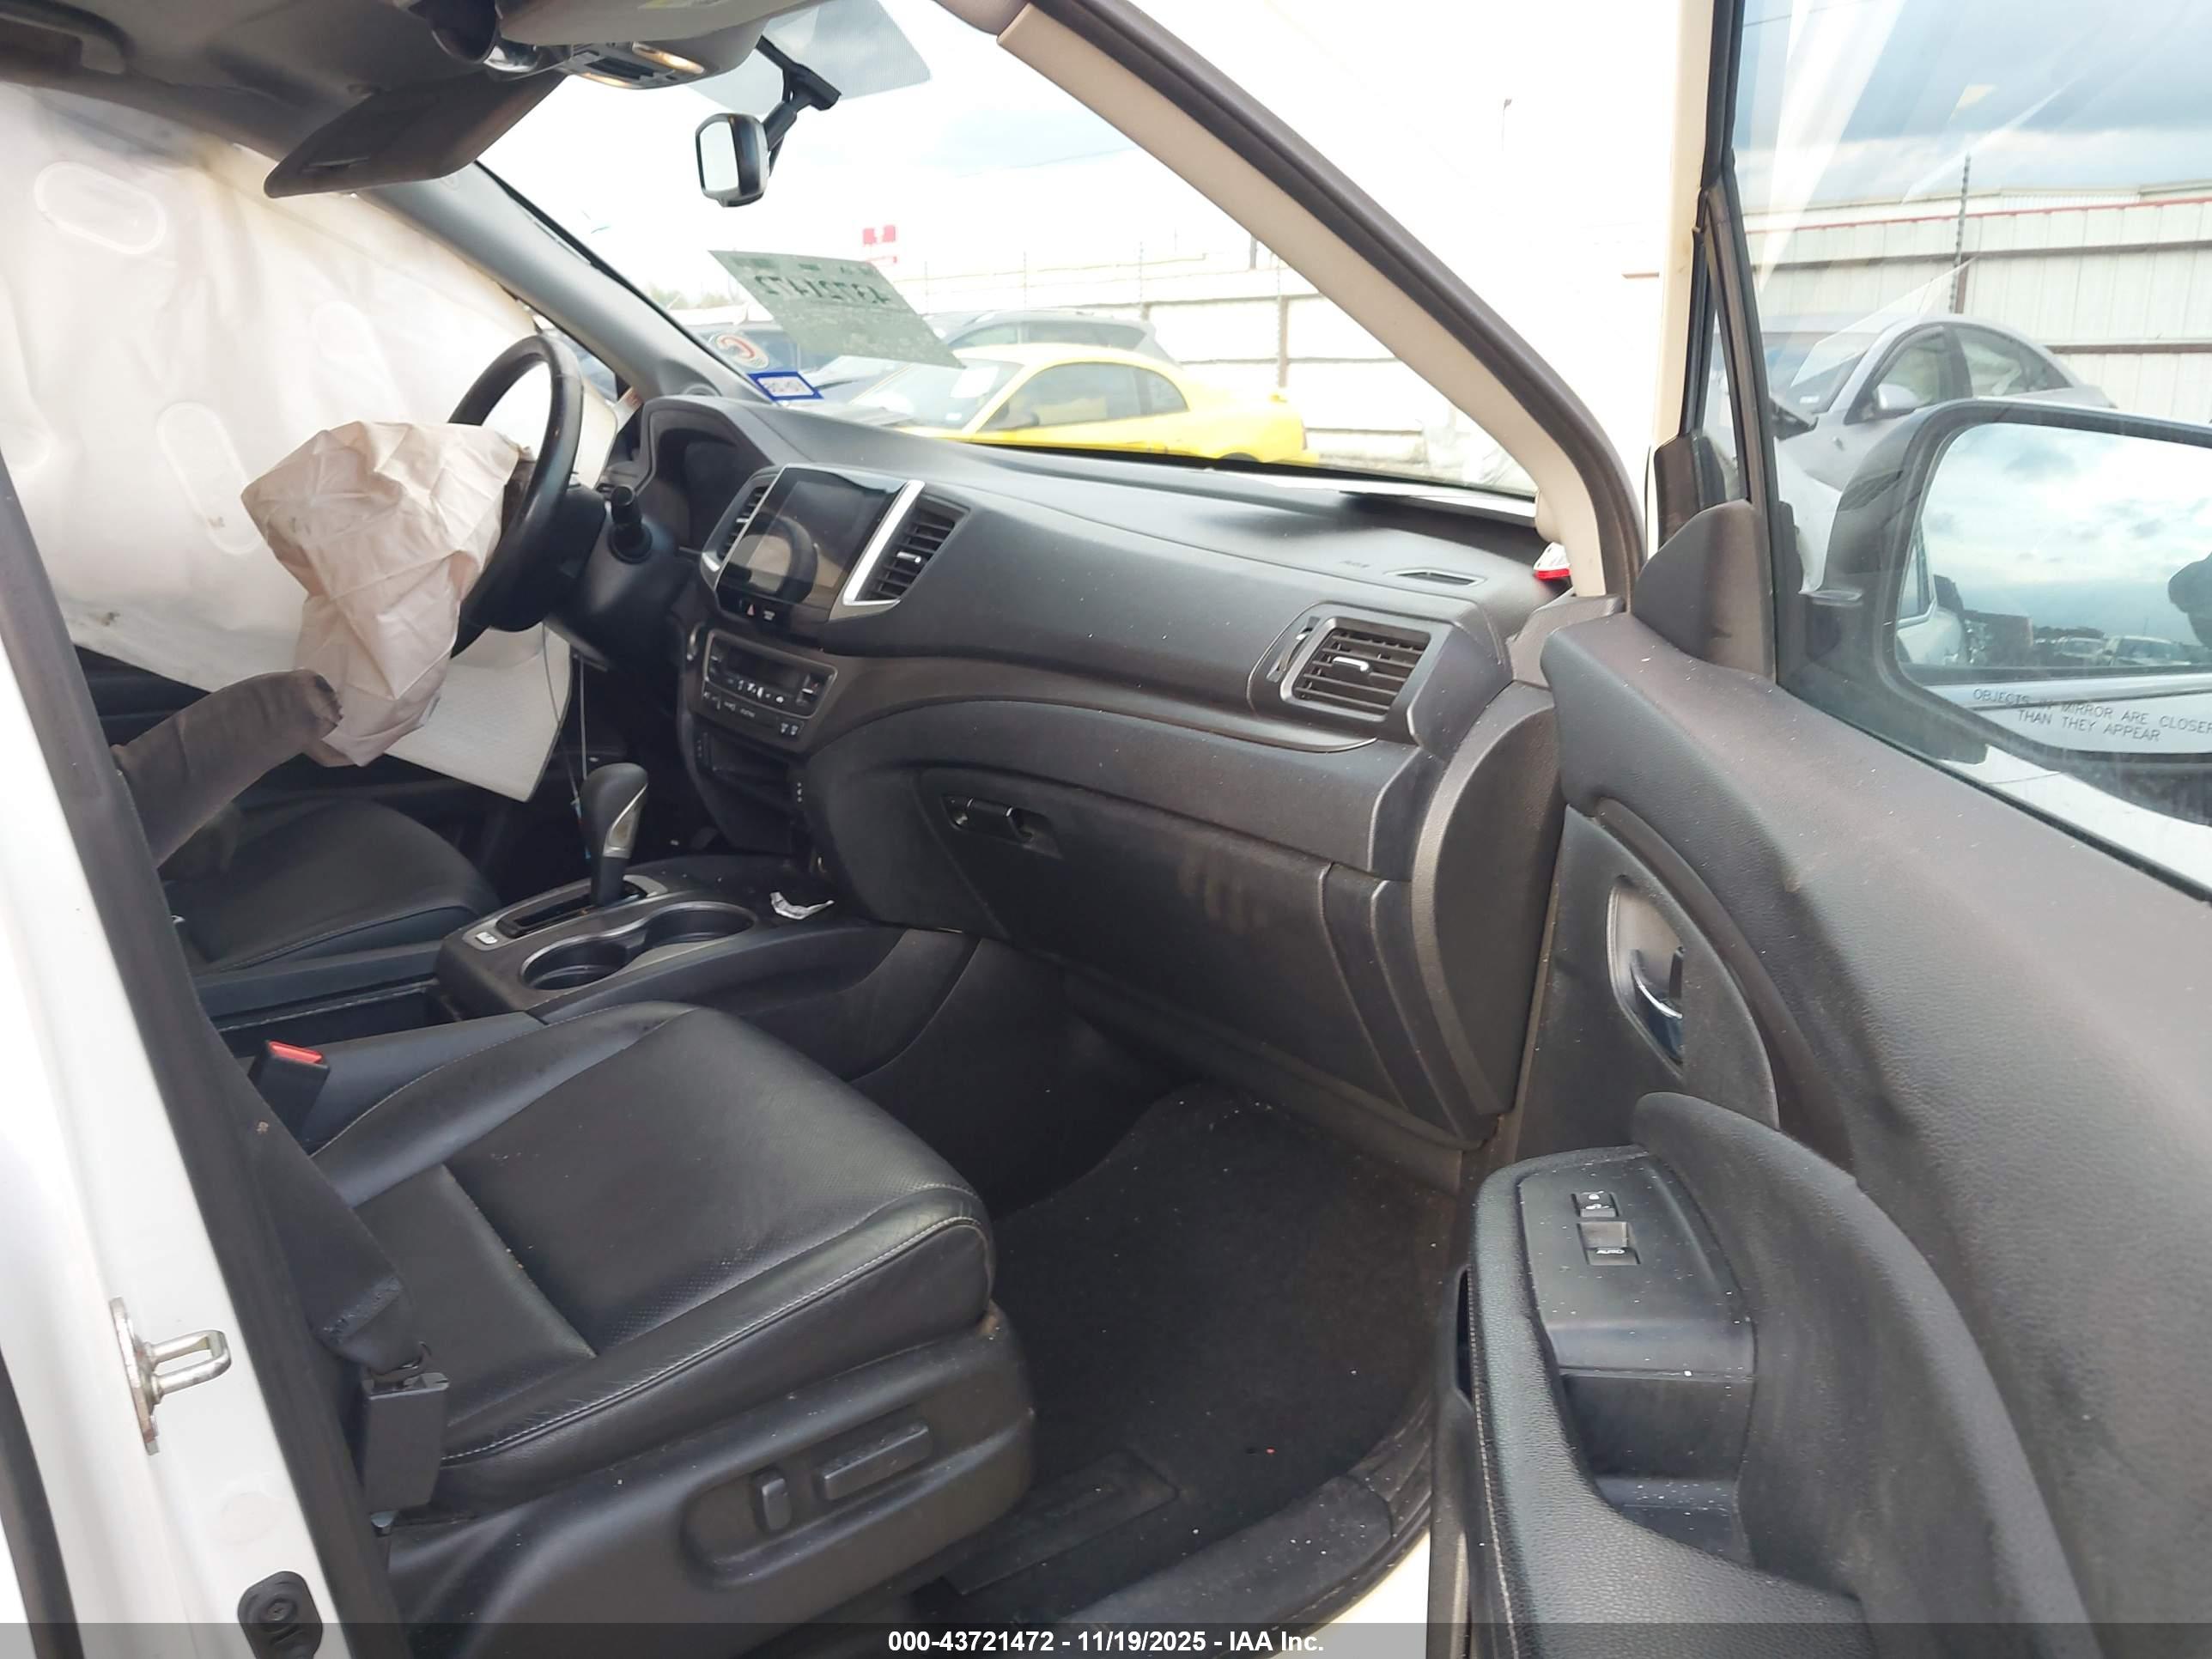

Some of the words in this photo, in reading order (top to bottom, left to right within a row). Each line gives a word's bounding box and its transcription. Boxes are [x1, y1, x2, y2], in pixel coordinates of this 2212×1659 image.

[1972, 688, 2031, 705] OBJECTS
[2061, 702, 2113, 720] MIRROR
[2121, 710, 2149, 725] ARE
[2018, 709, 2052, 725] THAN
[2062, 716, 2096, 732] THEY
[2103, 723, 2160, 742] APPEAR
